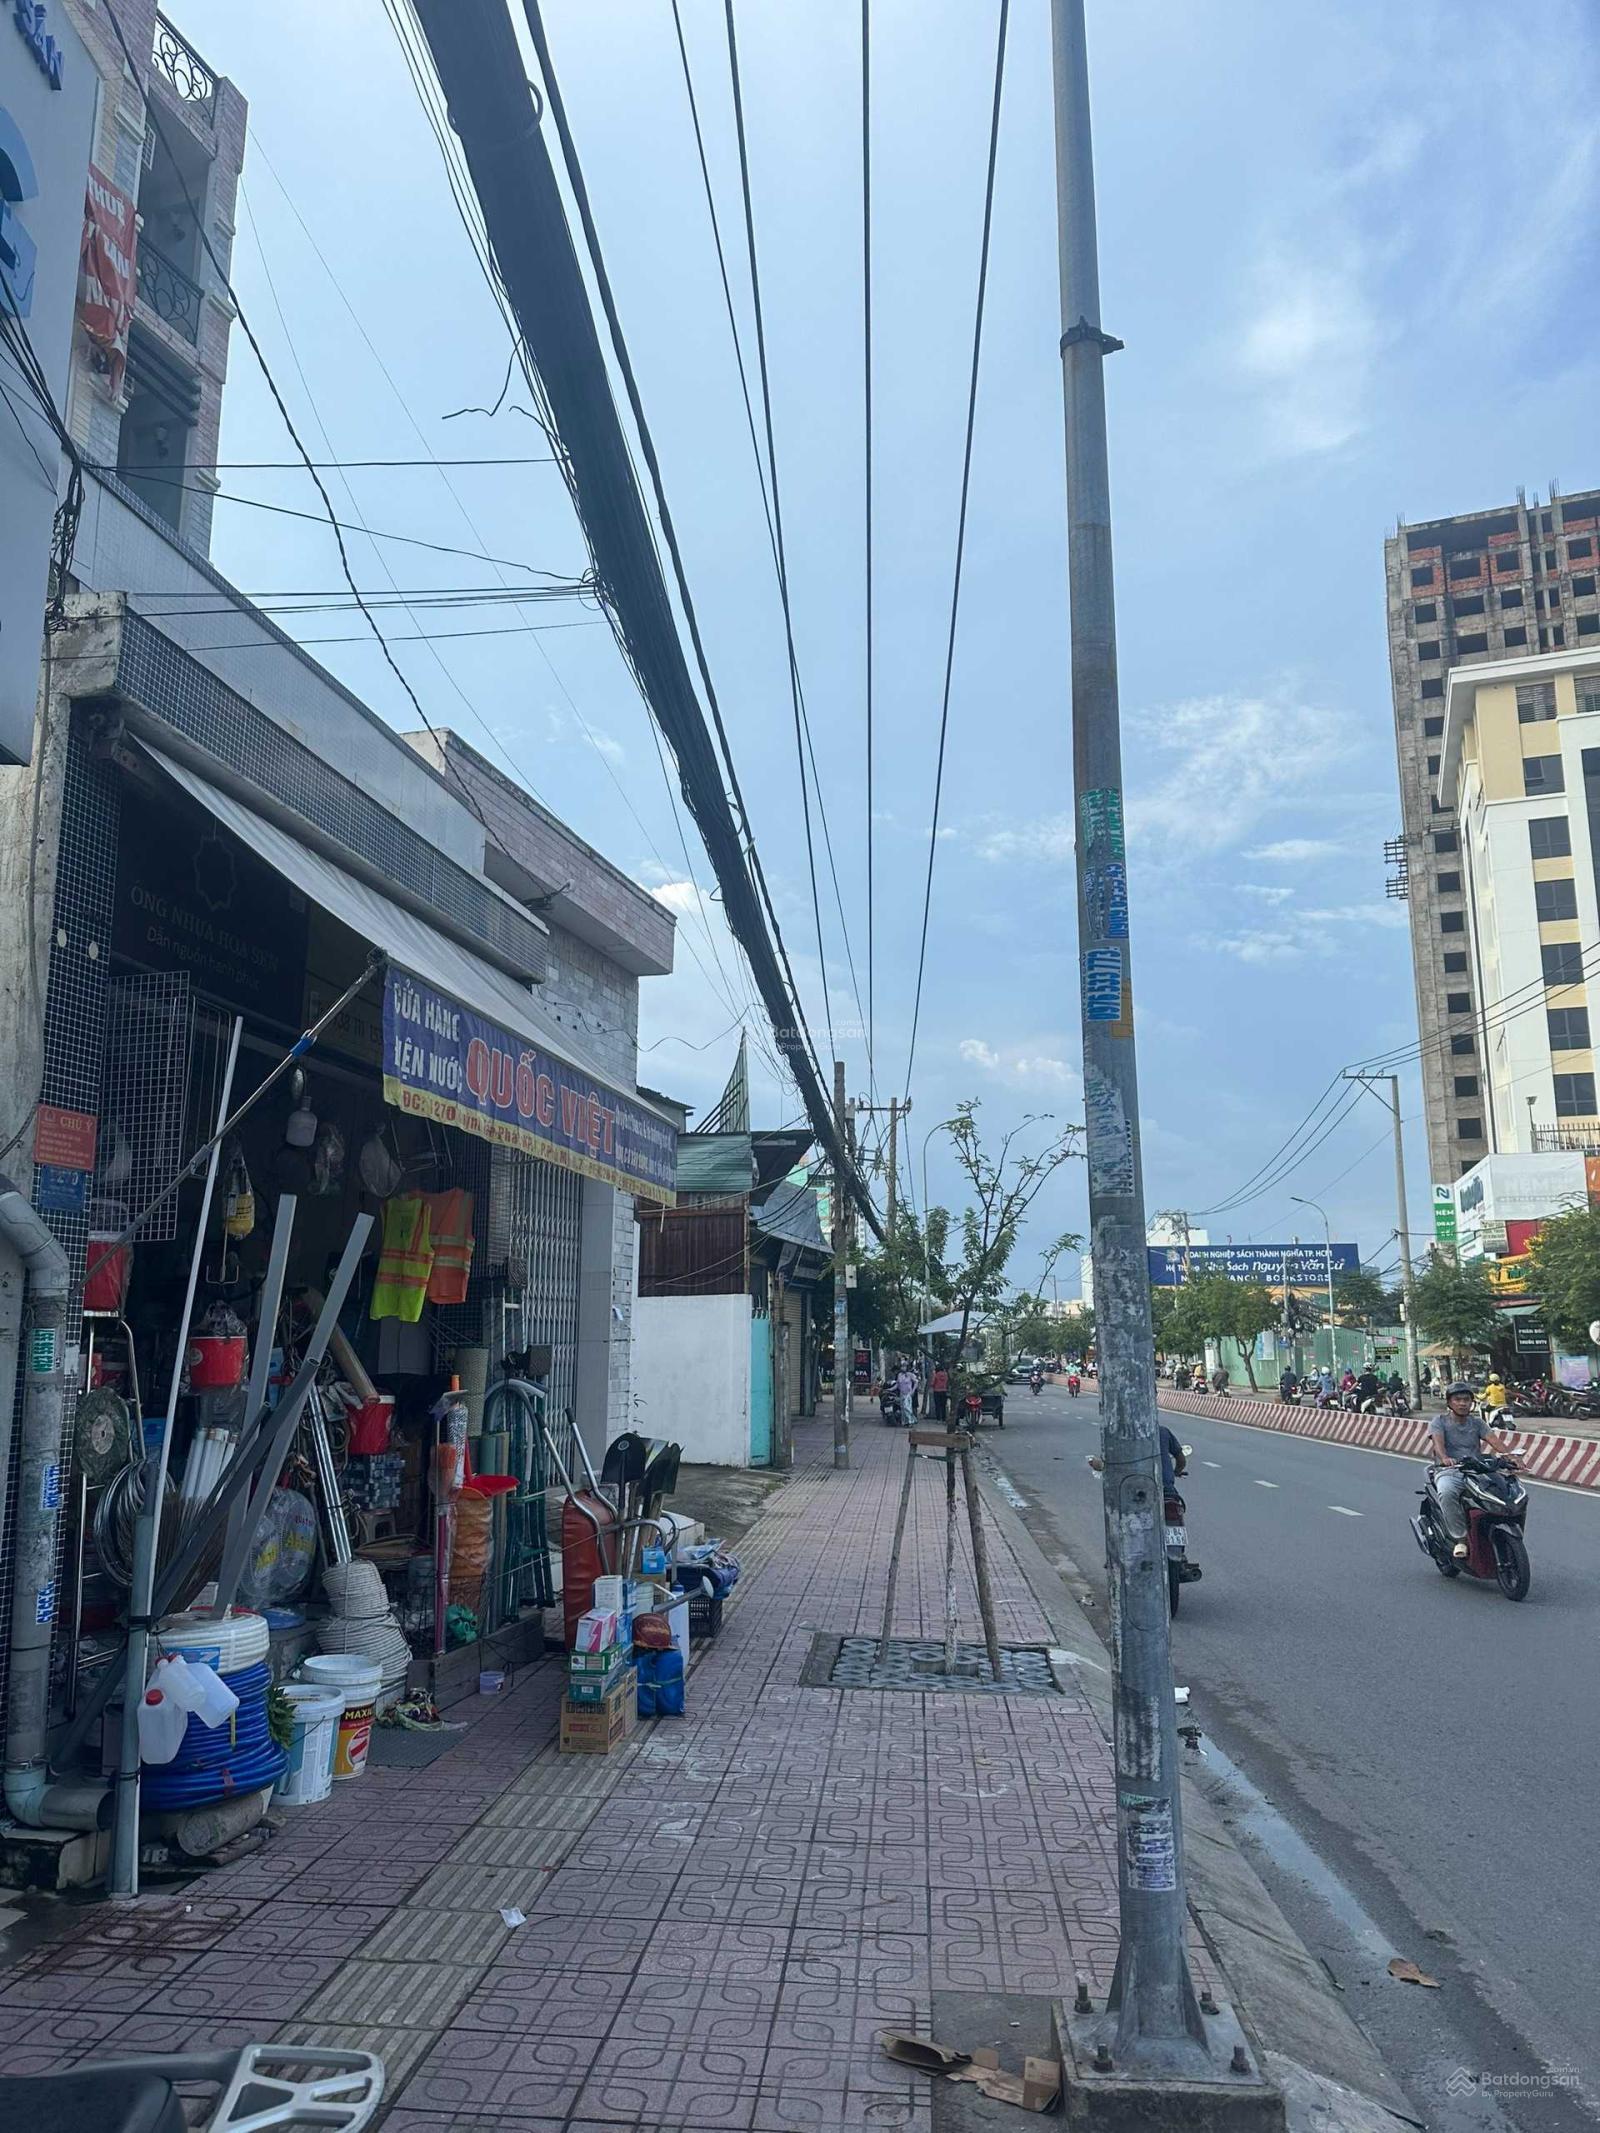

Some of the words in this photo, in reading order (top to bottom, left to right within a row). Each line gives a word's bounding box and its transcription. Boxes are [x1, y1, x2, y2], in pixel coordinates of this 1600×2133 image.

[466, 1037, 555, 1127] QUỐC
[560, 1083, 616, 1159] VIỆT
[1236, 1249, 1254, 1258] SÁCH
[1255, 1249, 1279, 1258] THÀNH
[1226, 1260, 1249, 1271] Sách
